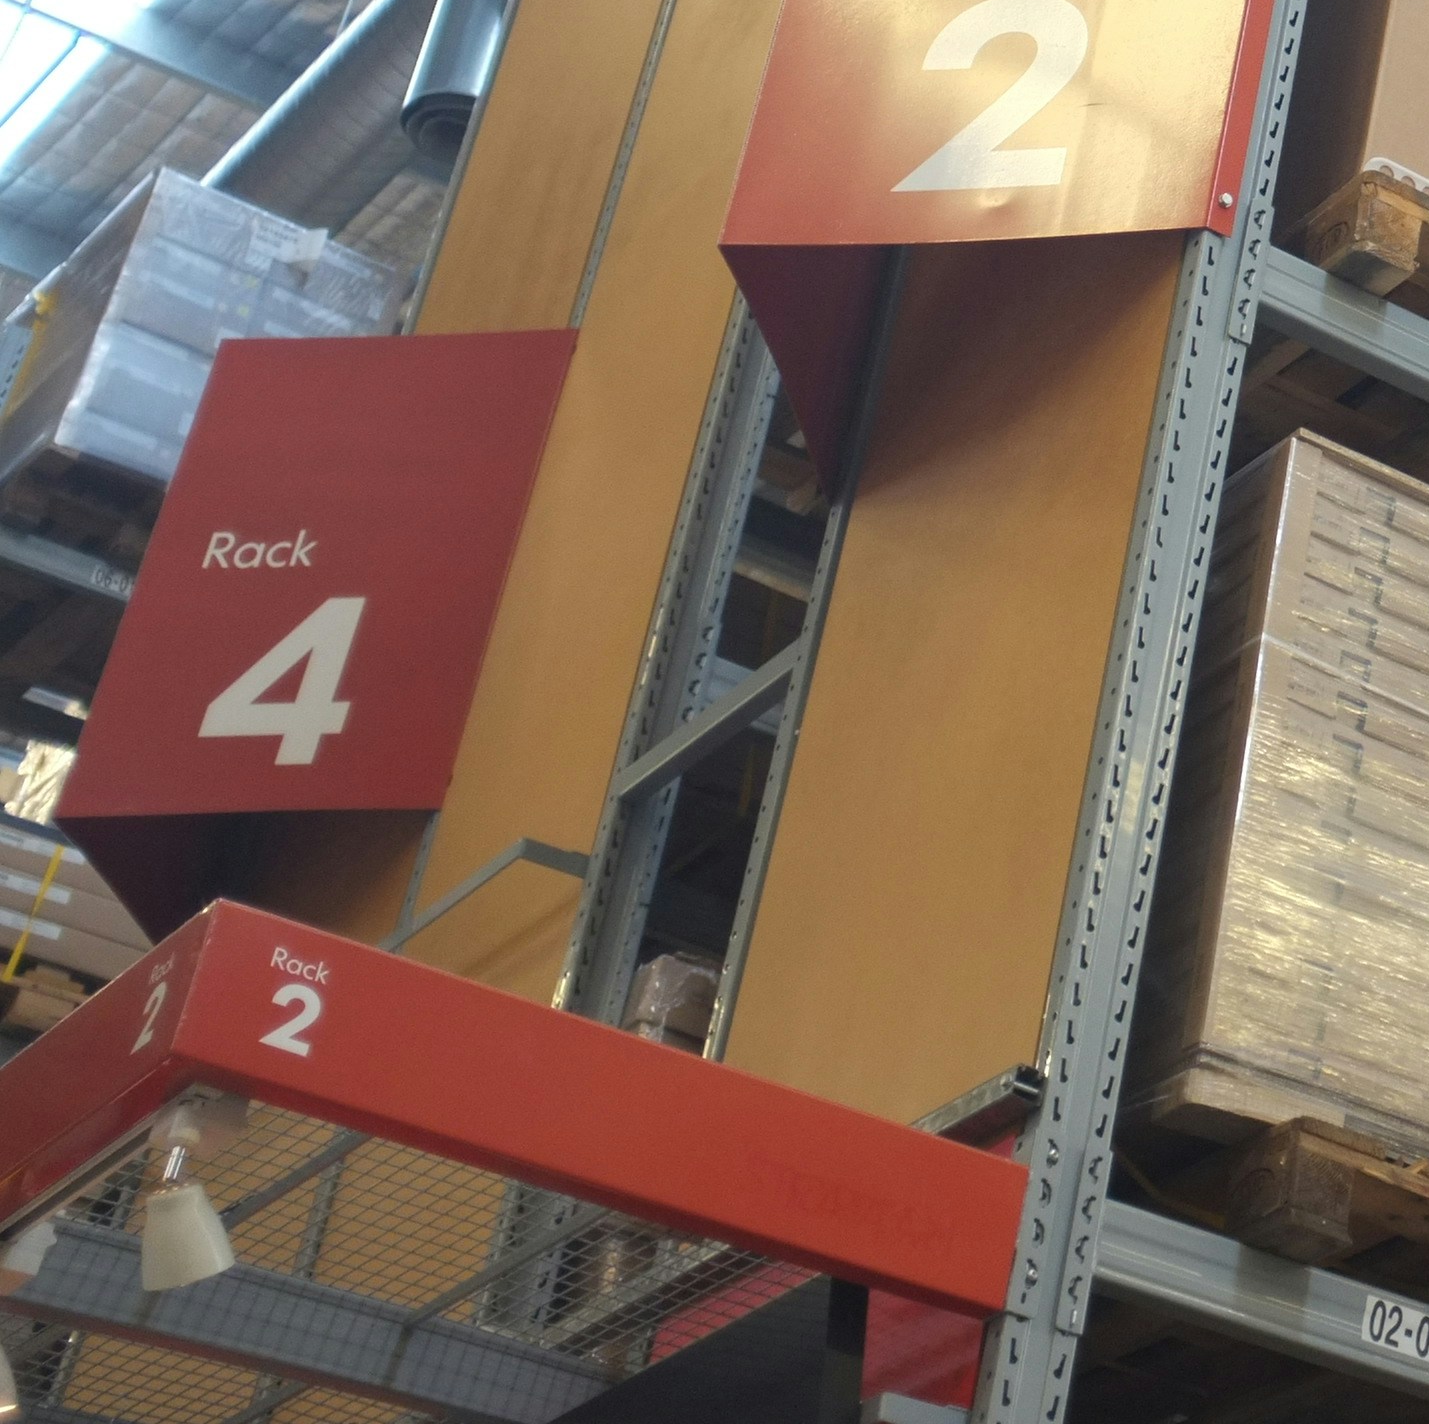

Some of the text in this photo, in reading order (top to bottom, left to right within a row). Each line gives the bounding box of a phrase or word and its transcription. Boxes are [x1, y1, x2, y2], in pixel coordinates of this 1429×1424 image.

[202, 529, 318, 570] Rack
[197, 596, 366, 766] 4
[271, 947, 330, 985] Rack
[130, 980, 166, 1055] 2
[259, 983, 322, 1058] 2
